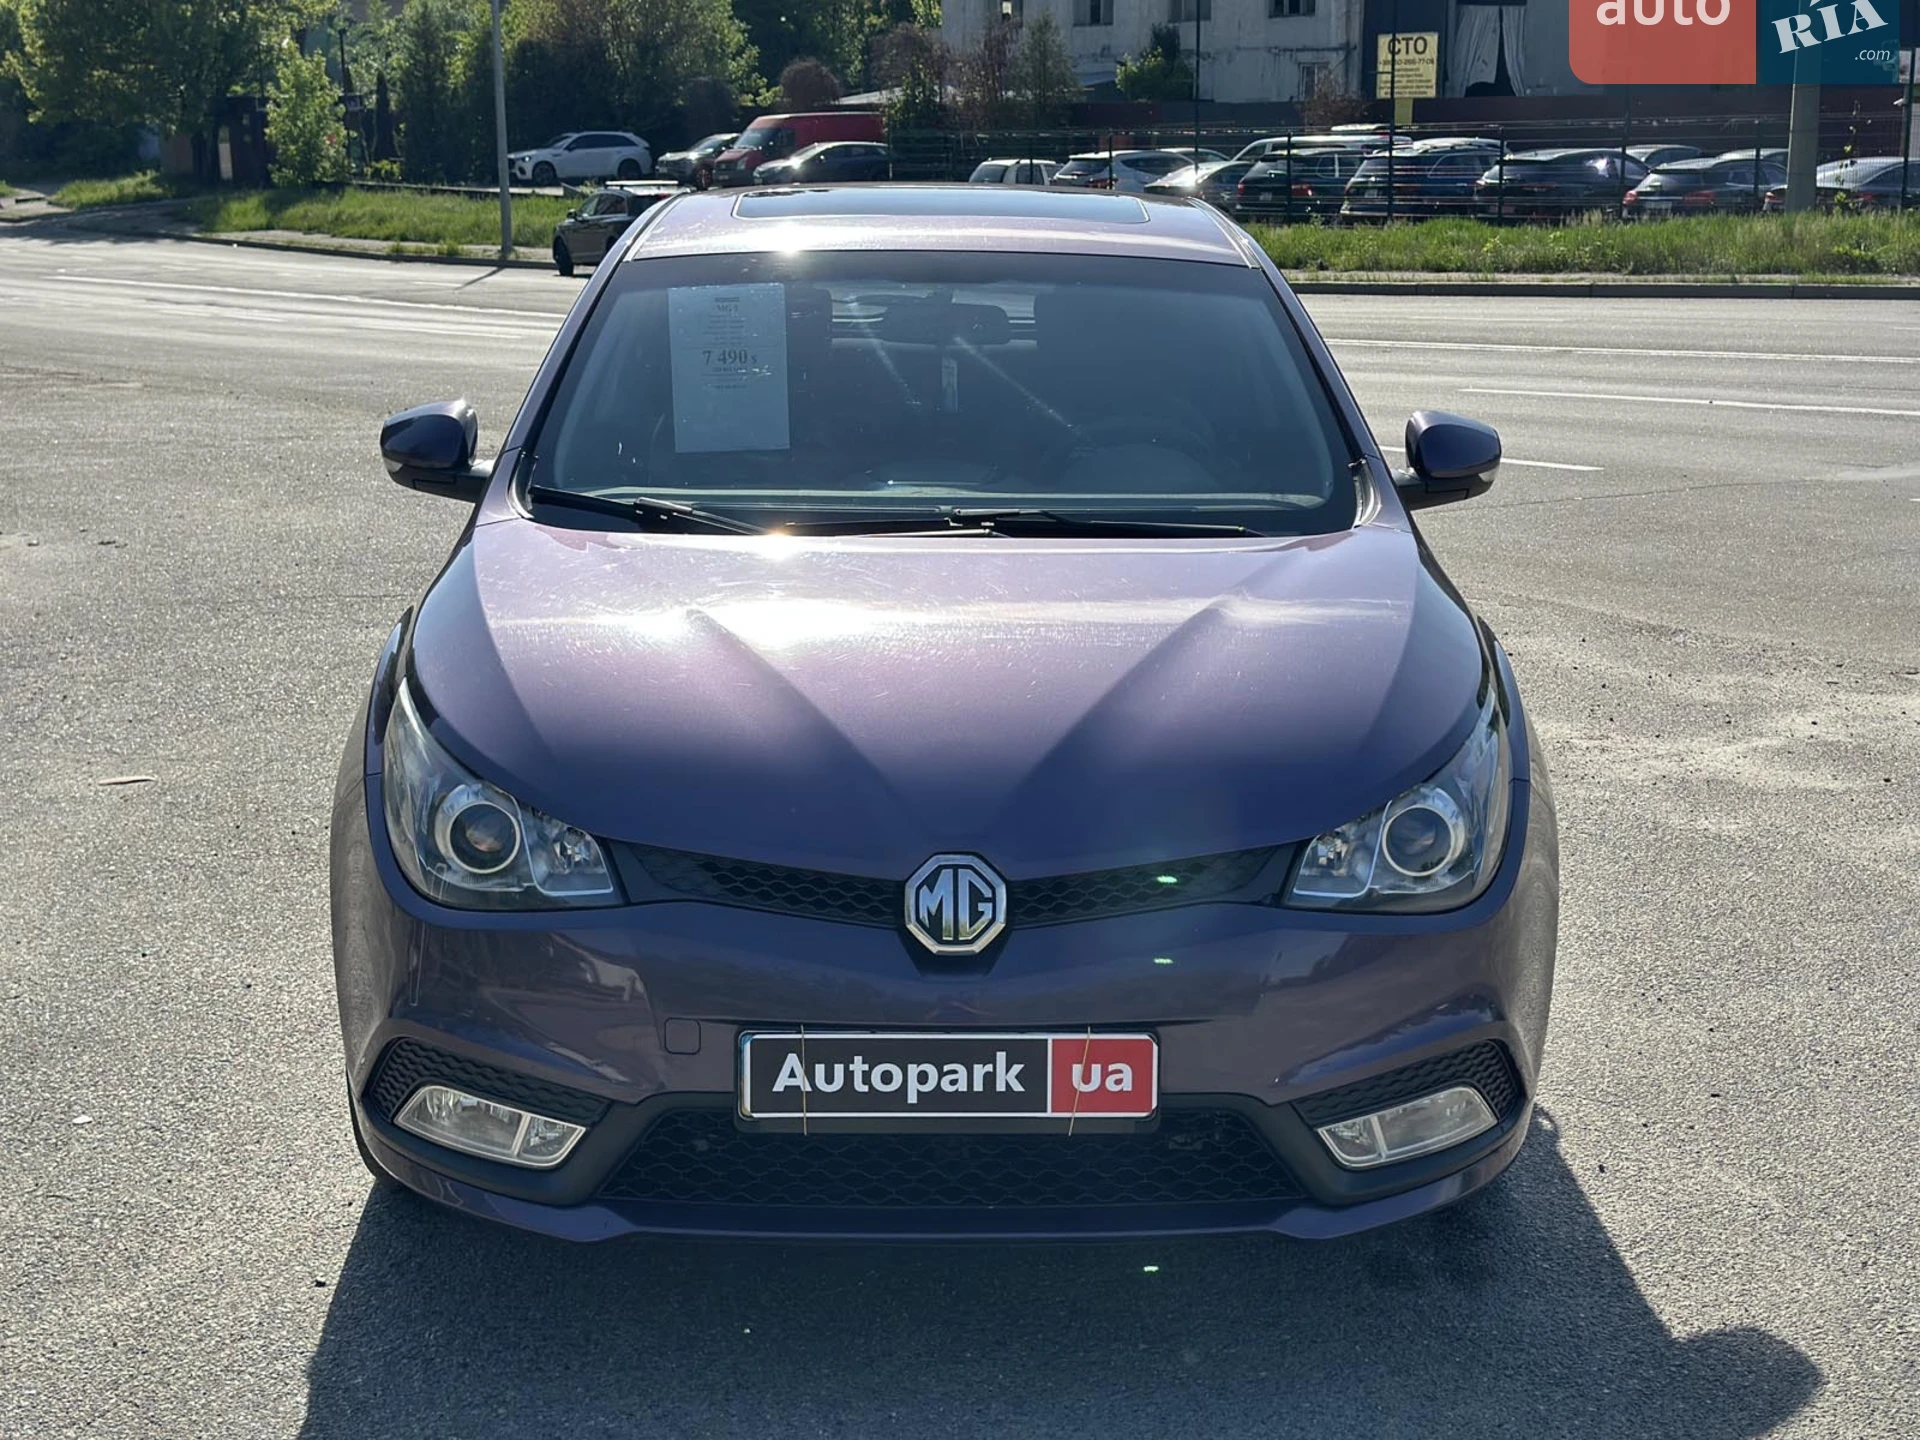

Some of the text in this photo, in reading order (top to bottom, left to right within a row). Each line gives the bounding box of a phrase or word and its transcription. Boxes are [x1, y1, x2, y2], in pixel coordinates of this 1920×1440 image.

[1388, 36, 1428, 55] СТО
[702, 349, 712, 365] 7
[717, 349, 748, 364] 490
[918, 867, 994, 942] MG
[771, 1051, 1134, 1105] Autopark ua
